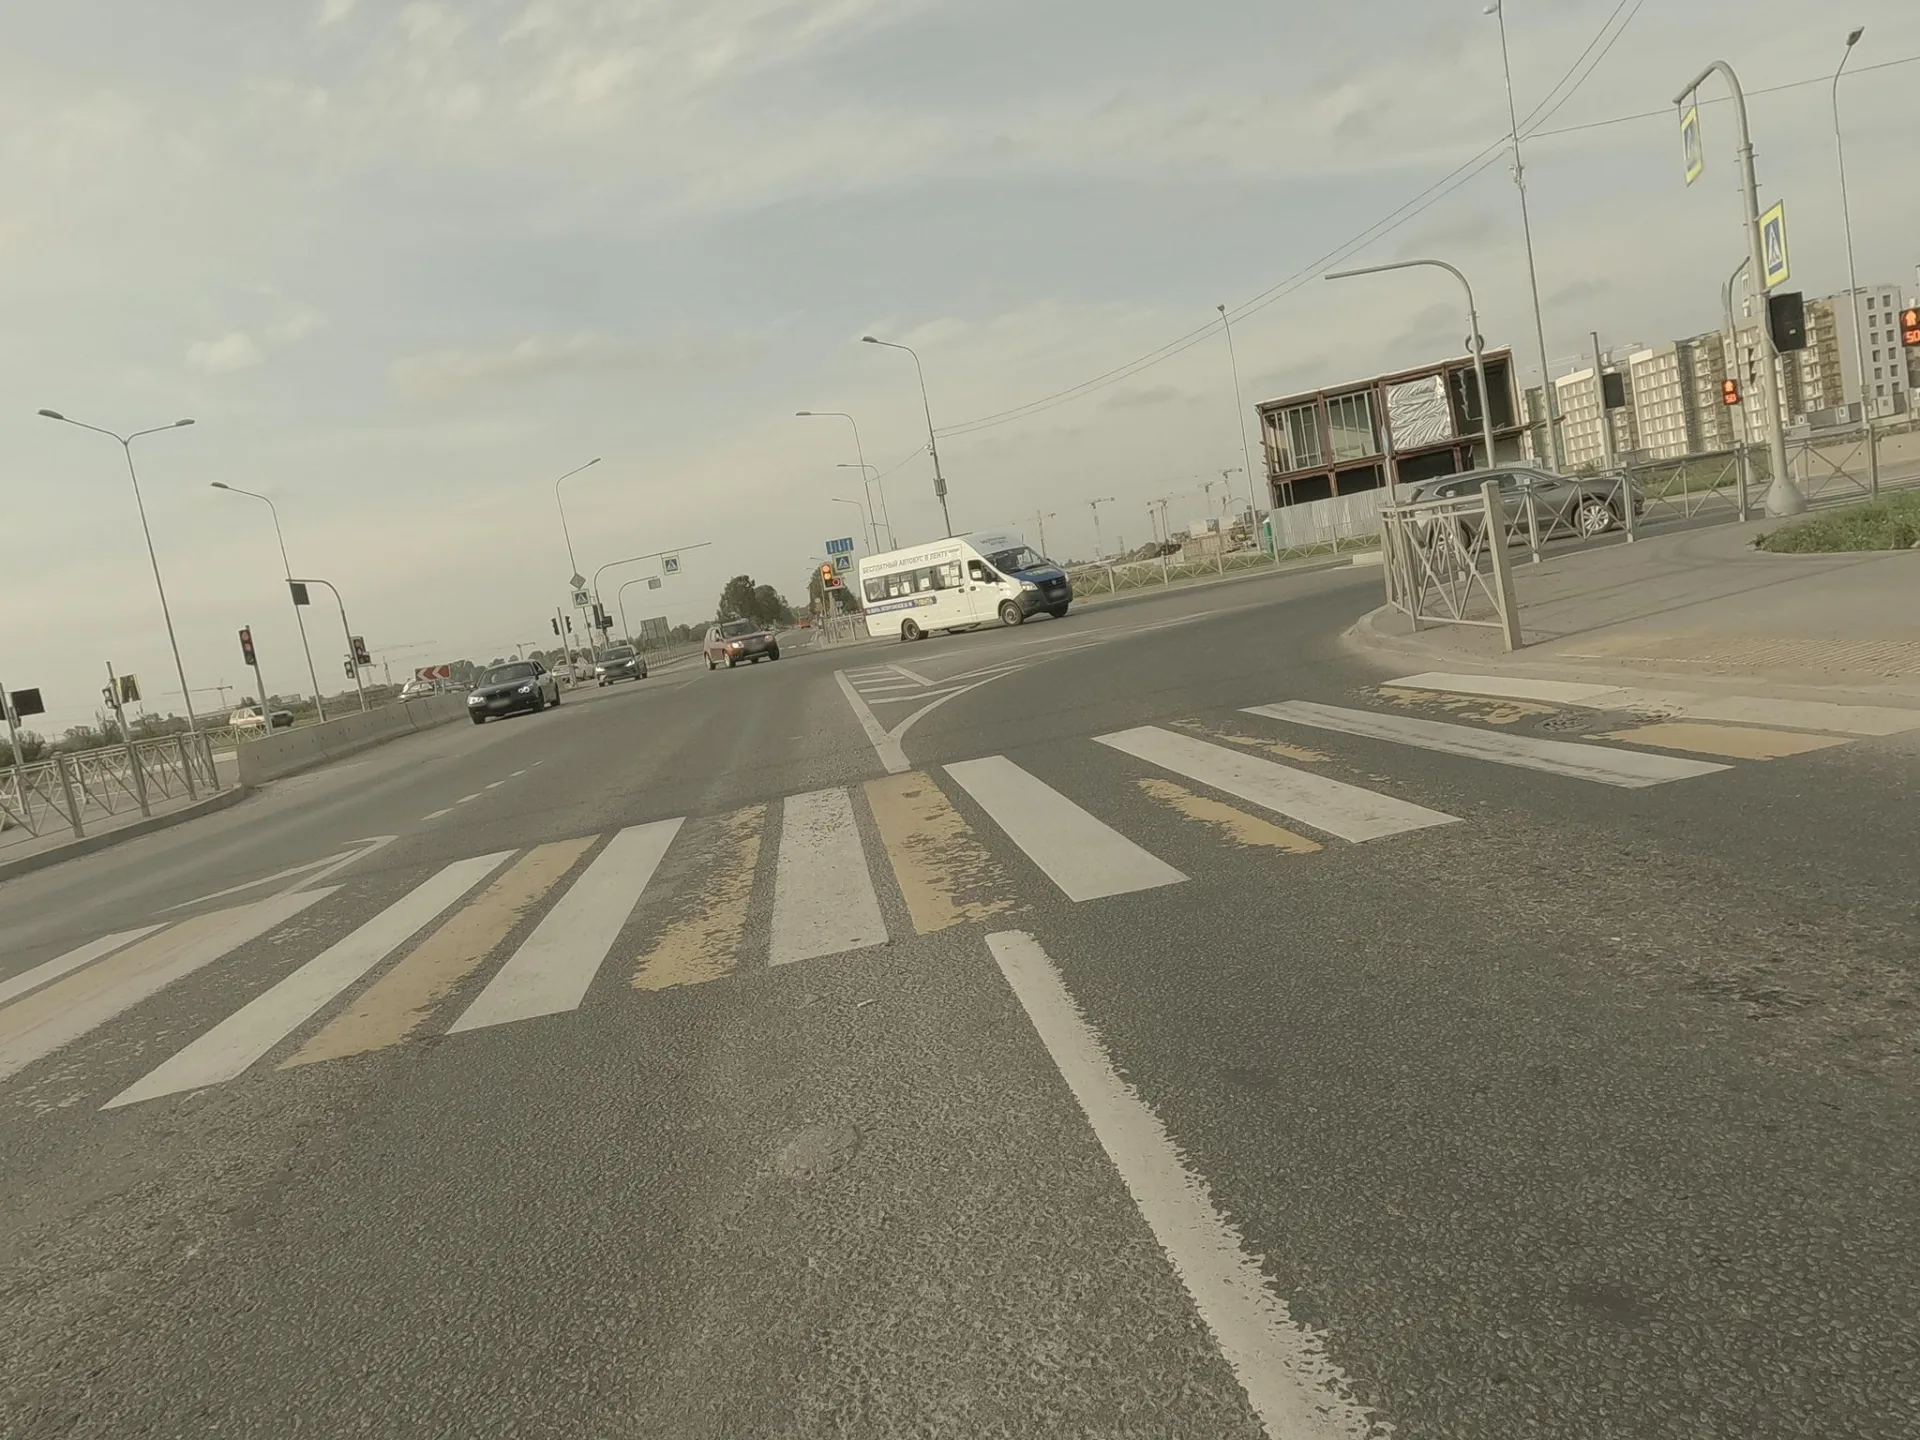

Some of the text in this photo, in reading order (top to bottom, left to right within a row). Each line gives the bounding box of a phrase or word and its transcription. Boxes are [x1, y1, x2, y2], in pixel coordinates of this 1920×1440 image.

[862, 560, 898, 574] БЕСПЛАТНЫЙ
[899, 556, 923, 567] АВТОБУС
[929, 552, 948, 560] ЛЕНТУ
